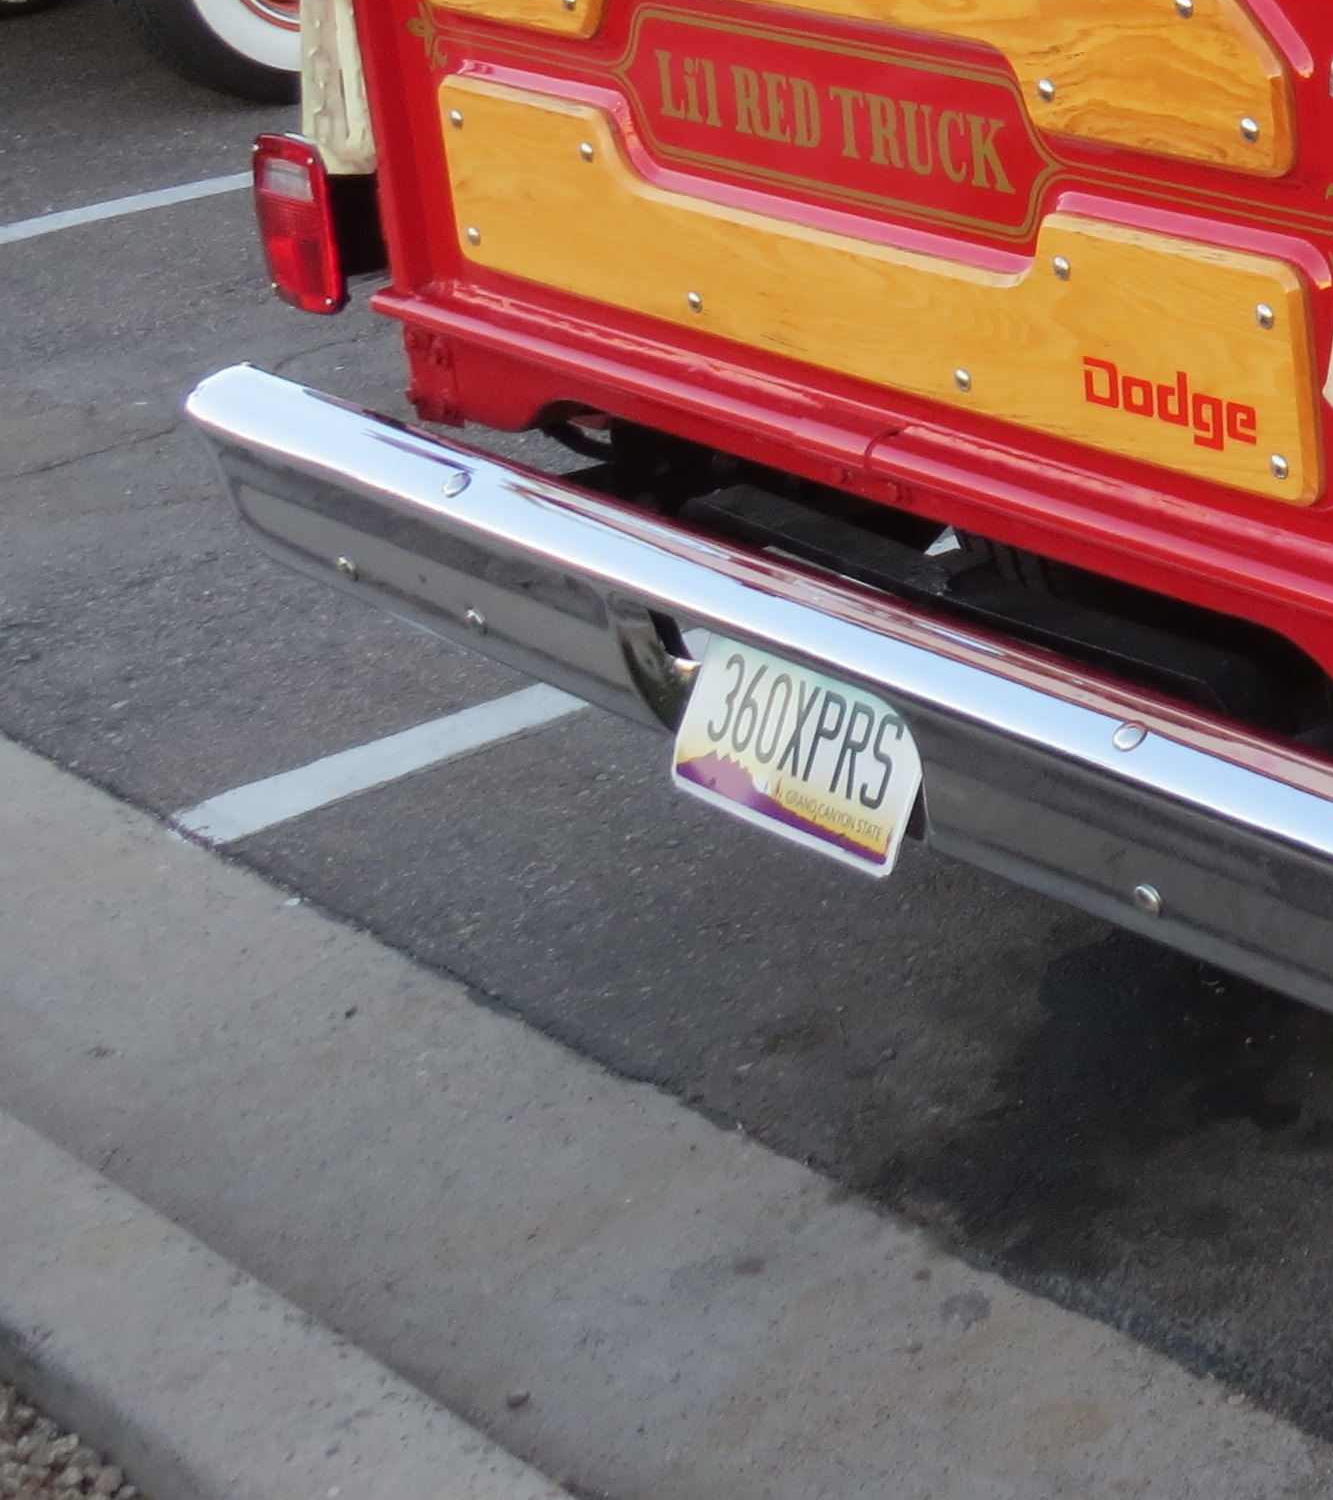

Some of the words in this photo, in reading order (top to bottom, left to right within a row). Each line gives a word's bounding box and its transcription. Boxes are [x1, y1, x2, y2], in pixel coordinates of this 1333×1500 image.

[729, 64, 821, 149] RED
[829, 85, 1016, 195] TRUCK
[1083, 356, 1257, 451] Dodge
[707, 653, 904, 810] 360XPRS
[785, 789, 817, 814] GRAND
[817, 803, 857, 830] CANYON
[856, 819, 883, 841] STATE
